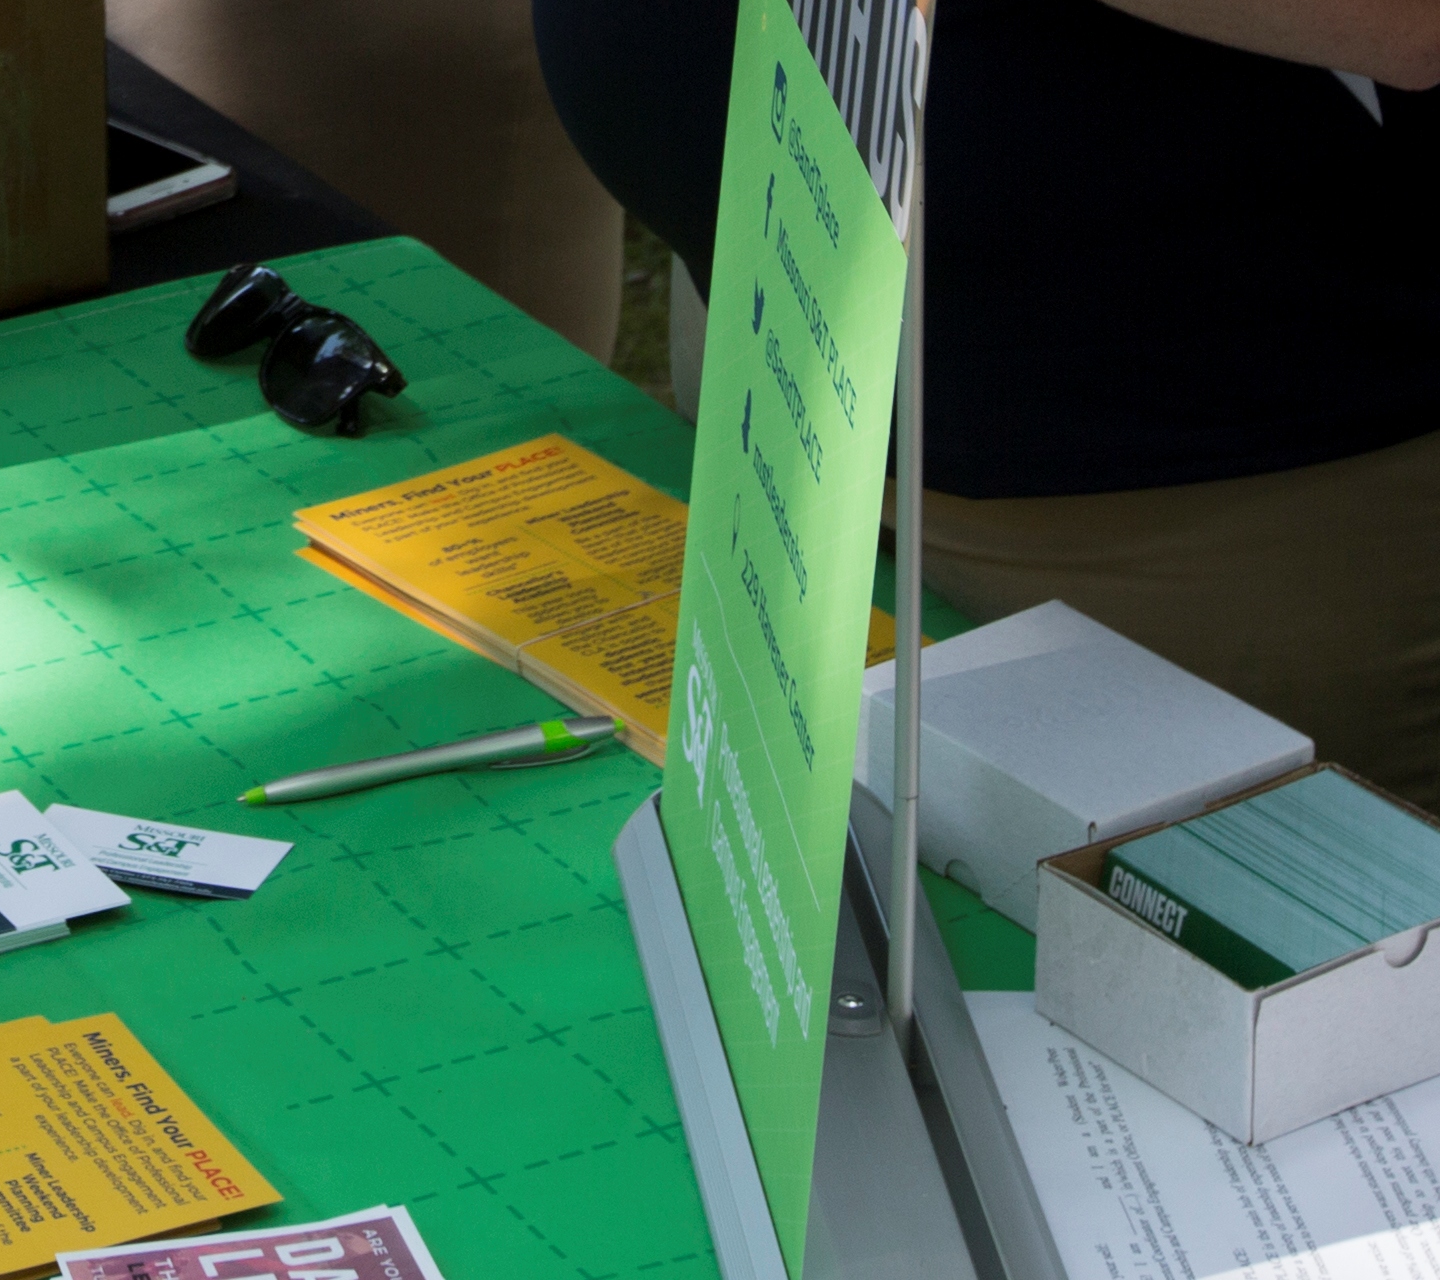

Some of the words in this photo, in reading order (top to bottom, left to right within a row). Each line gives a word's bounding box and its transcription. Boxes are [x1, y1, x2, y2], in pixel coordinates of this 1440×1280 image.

[786, 109, 842, 260] @SandTplace
[775, 216, 812, 325] Missouri
[808, 290, 829, 366] S&T
[826, 335, 857, 433] PLACE
[751, 428, 810, 609] mstleadership
[741, 544, 759, 615] 229
[756, 586, 790, 703] Havener
[787, 674, 816, 778] Center
[117, 829, 201, 860] S&T
[1108, 865, 1188, 938] CONNECT
[78, 1030, 142, 1083] Miners,
[123, 1081, 169, 1115] Find
[152, 1115, 198, 1150] Your
[183, 1148, 246, 1201] PLACE!
